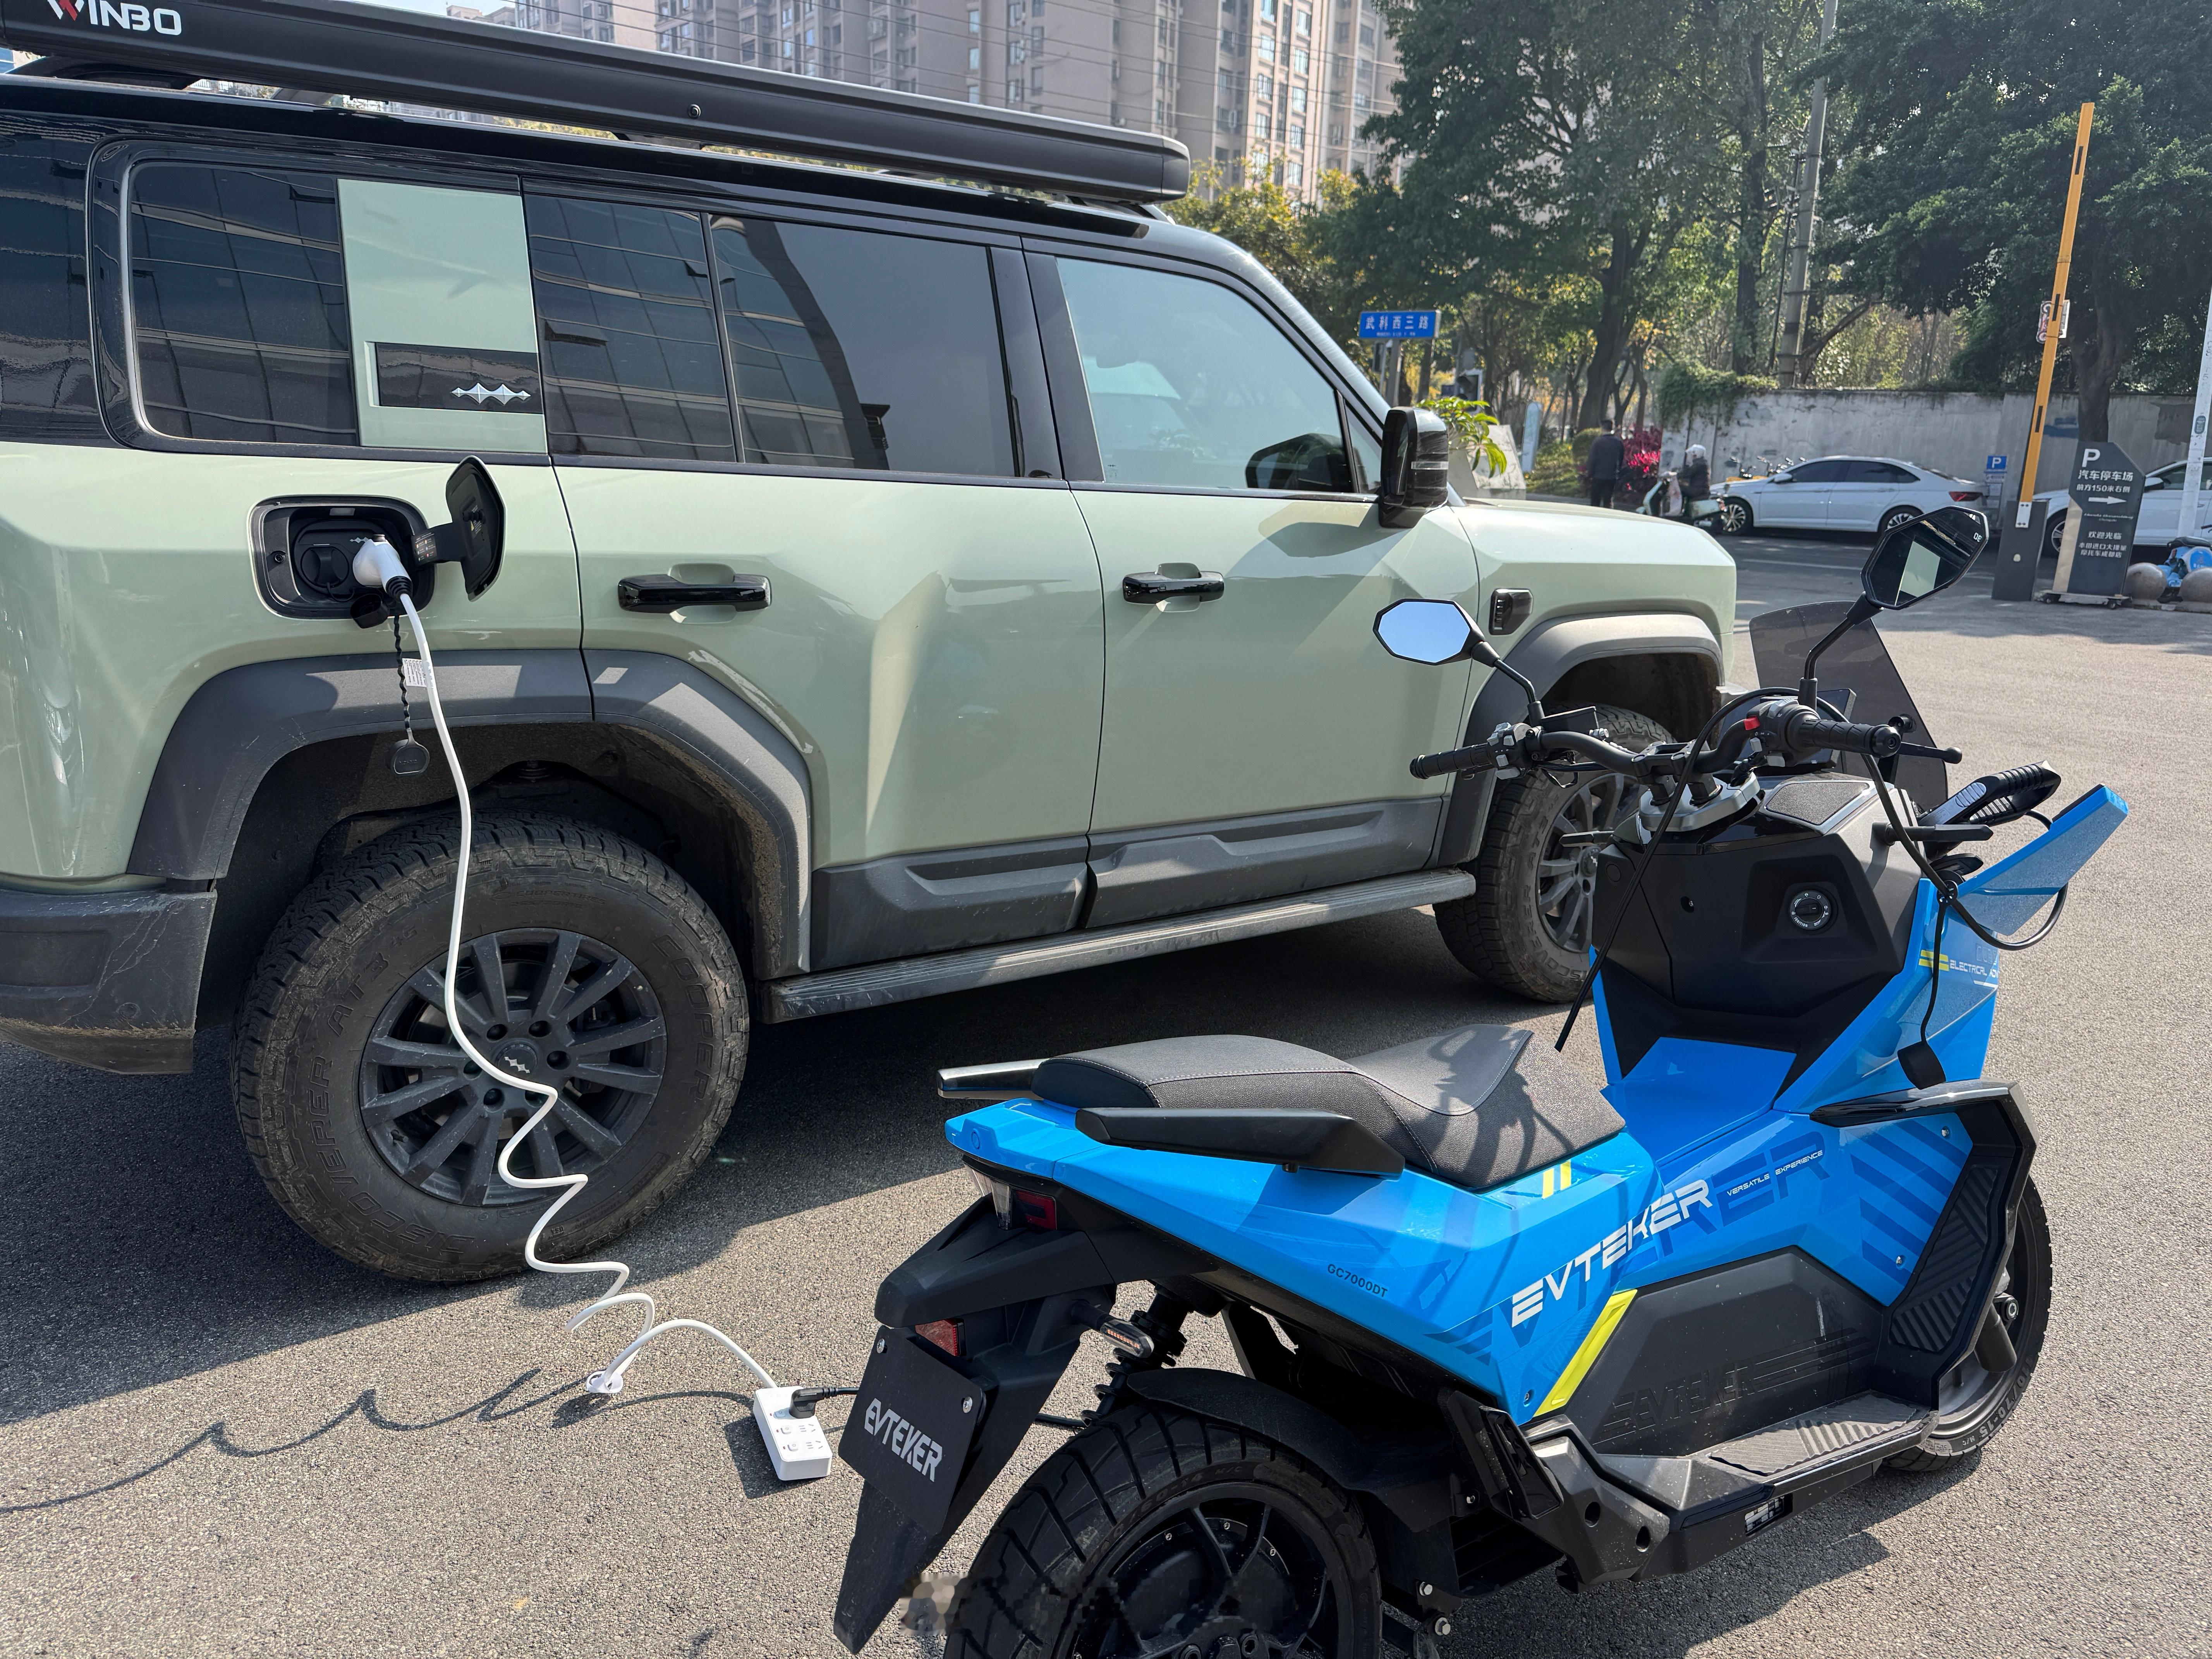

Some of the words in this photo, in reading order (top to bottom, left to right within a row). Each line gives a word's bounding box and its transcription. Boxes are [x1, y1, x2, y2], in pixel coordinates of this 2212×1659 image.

[47, 0, 182, 36] WINBO
[1365, 315, 1429, 330] 武科西三路
[1992, 457, 2001, 469] P
[2081, 448, 2100, 467] P
[2076, 484, 2131, 493] 前方150米右侧
[2078, 469, 2133, 482] 汽车停车场
[2088, 531, 2122, 540] 欢迎光临
[651, 934, 714, 1100] COOPER
[1727, 1173, 1770, 1197] VERSATILE
[1775, 1149, 1823, 1176] EXPERIENCE
[1511, 1179, 1713, 1328] EVTEKER
[1327, 1264, 1388, 1297] GC7000DT
[864, 1397, 943, 1482] EVTEKER
